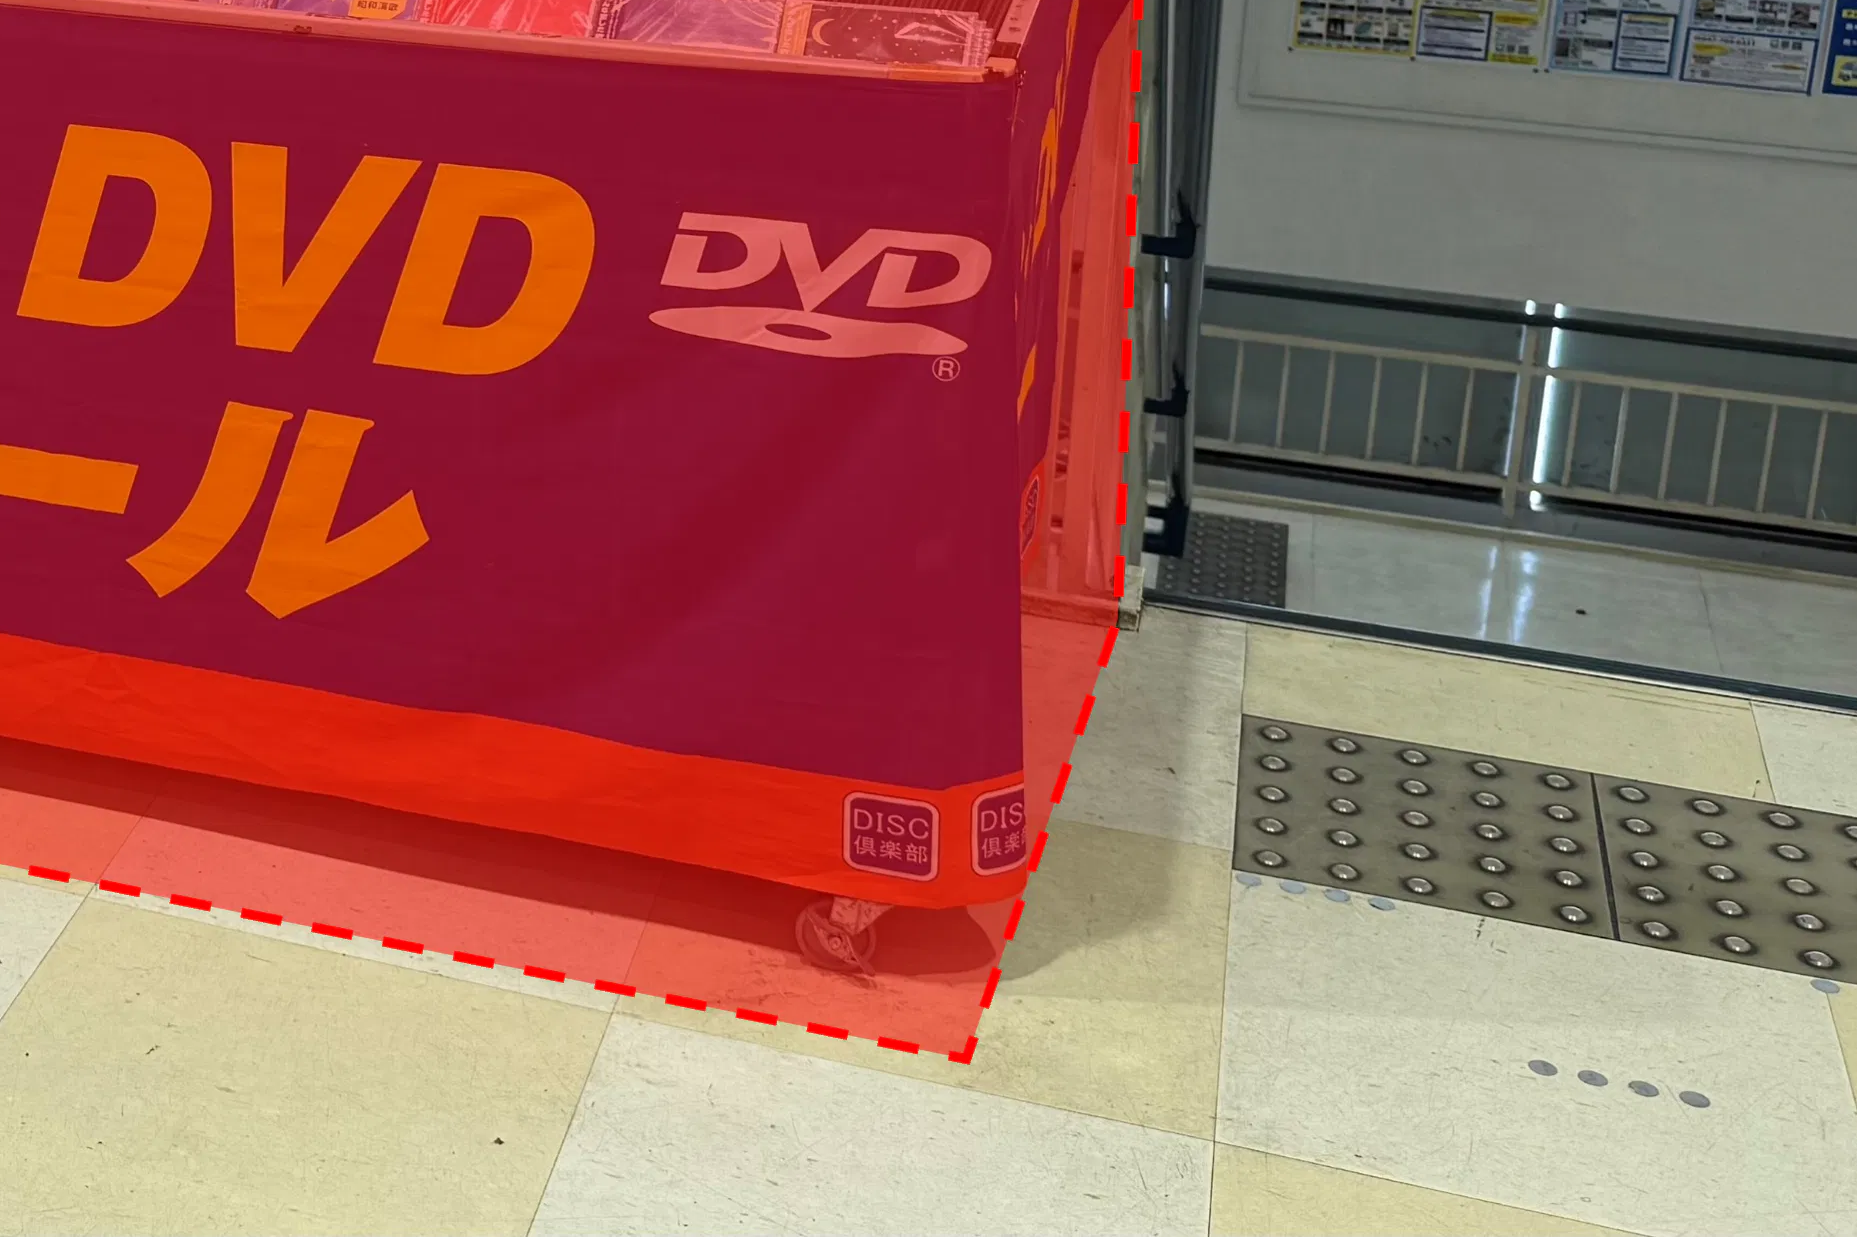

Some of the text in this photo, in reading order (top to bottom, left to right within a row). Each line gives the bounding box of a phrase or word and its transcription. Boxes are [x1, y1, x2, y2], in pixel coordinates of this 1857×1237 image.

[660, 211, 992, 314] DVD
[853, 808, 930, 839] DISC
[980, 804, 1025, 834] DIS
[853, 837, 929, 864] 倶楽部
